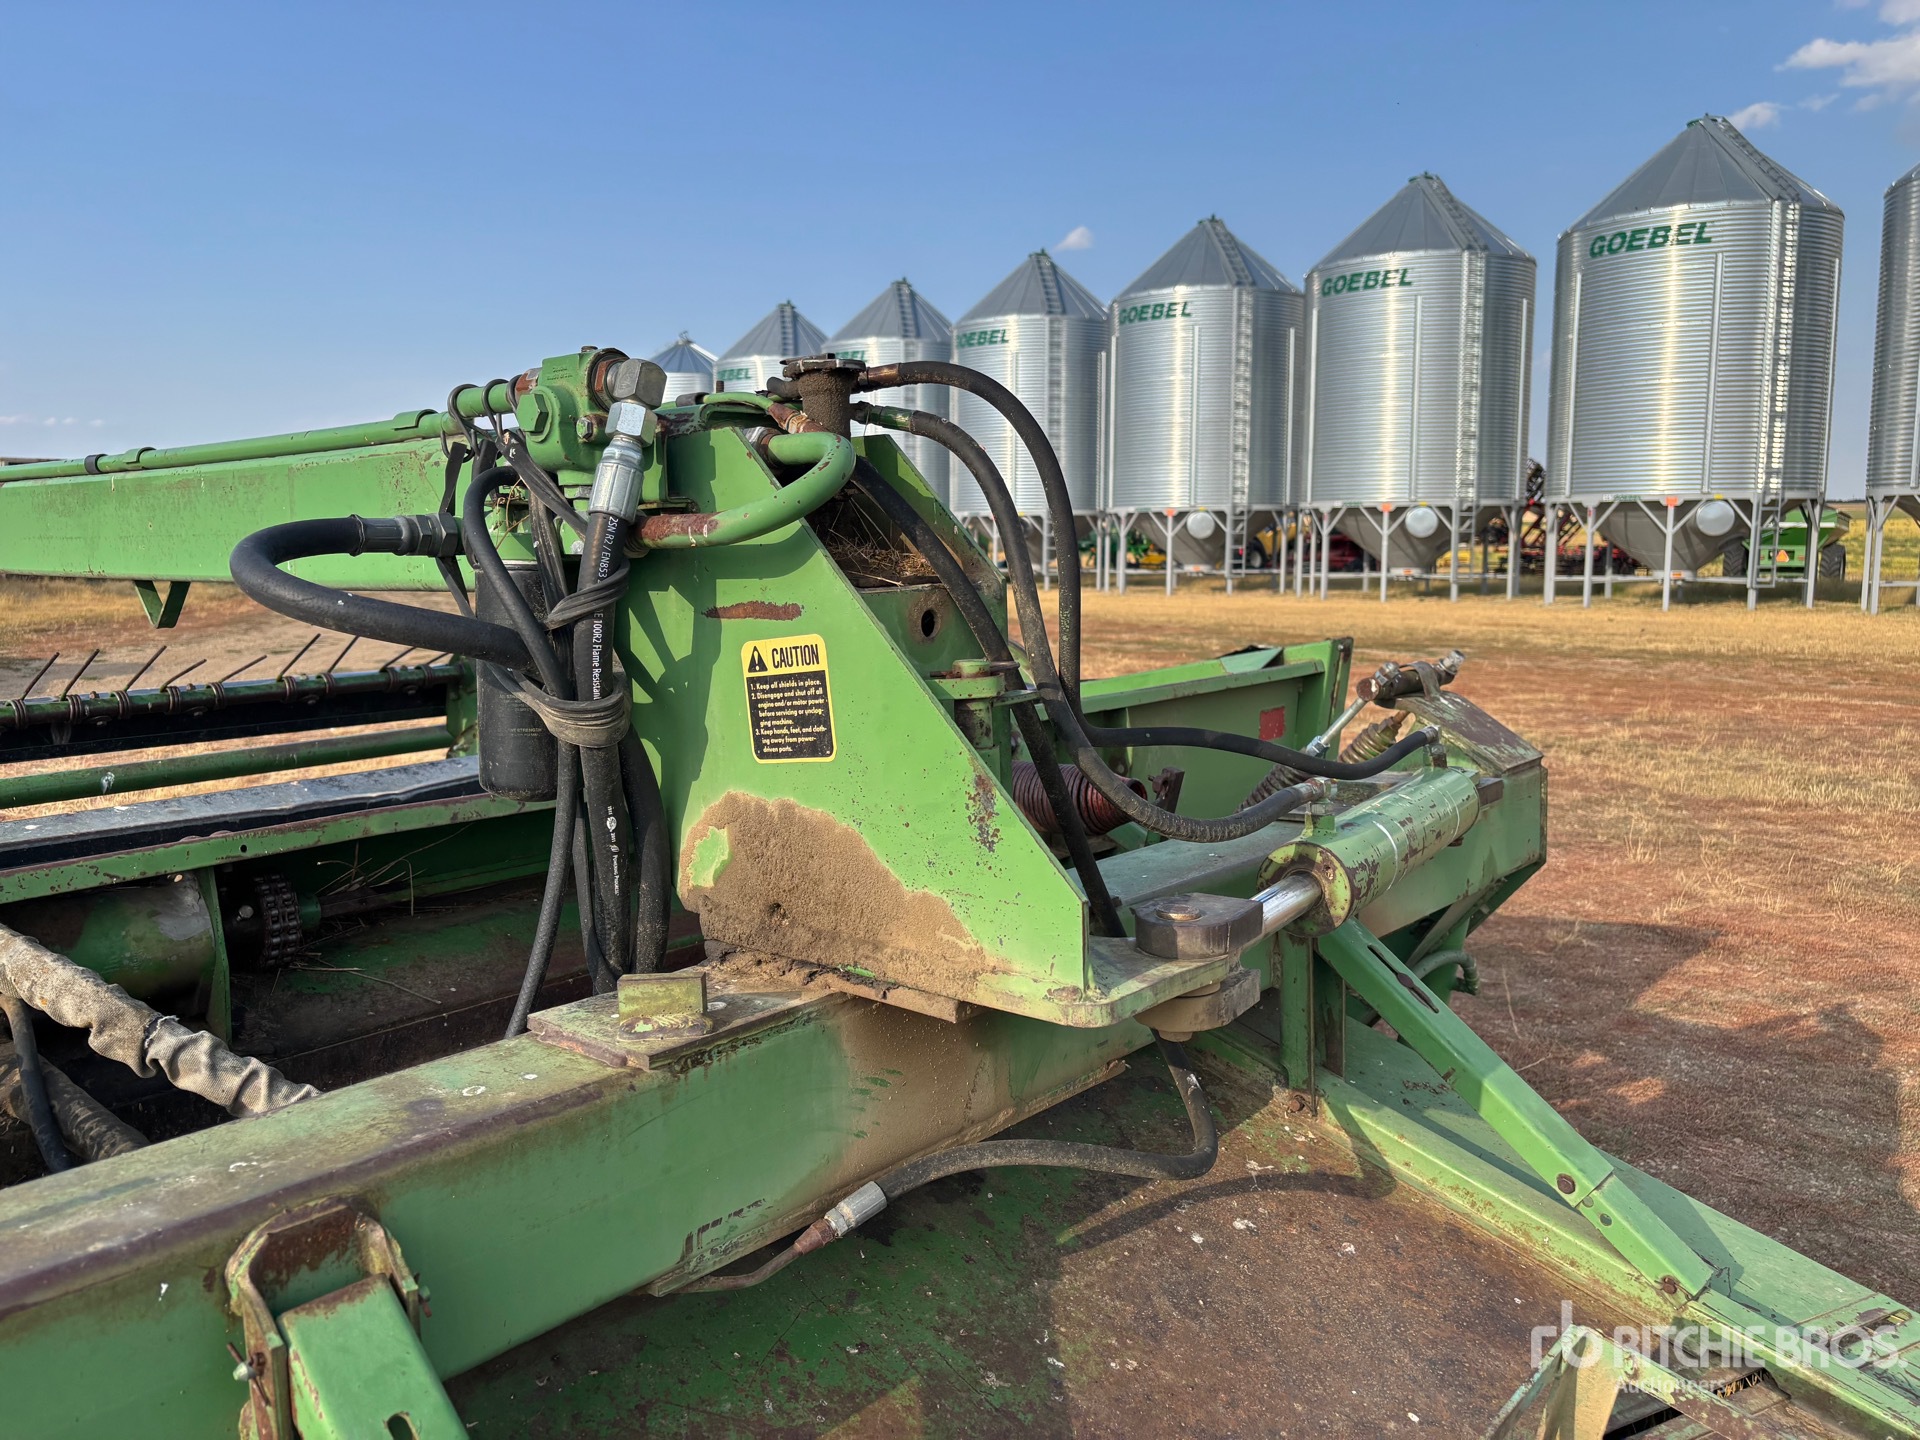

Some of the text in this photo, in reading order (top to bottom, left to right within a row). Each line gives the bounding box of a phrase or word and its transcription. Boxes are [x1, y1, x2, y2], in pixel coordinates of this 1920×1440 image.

[1590, 222, 1712, 258] GOEBEL
[1321, 268, 1412, 296] GOEBEL
[1120, 302, 1191, 324] GOEBEL
[607, 516, 618, 533] 2SN
[604, 533, 615, 545] R2
[598, 552, 611, 578] EN853
[592, 620, 603, 643] 100R2
[592, 644, 602, 667] Flame
[771, 644, 820, 669] CAUTION
[779, 680, 797, 688] shields
[805, 679, 821, 687] place.
[757, 692, 783, 700] Disengage
[795, 689, 806, 697] shut
[807, 688, 815, 696] off
[758, 701, 774, 709] engine
[805, 707, 824, 716] unclog-
[761, 728, 773, 736] Keep
[773, 726, 790, 735] hands,
[790, 726, 802, 734] feet,
[802, 725, 812, 733] and
[785, 735, 797, 743] from
[798, 736, 817, 744] power-
[779, 745, 793, 753] parts.
